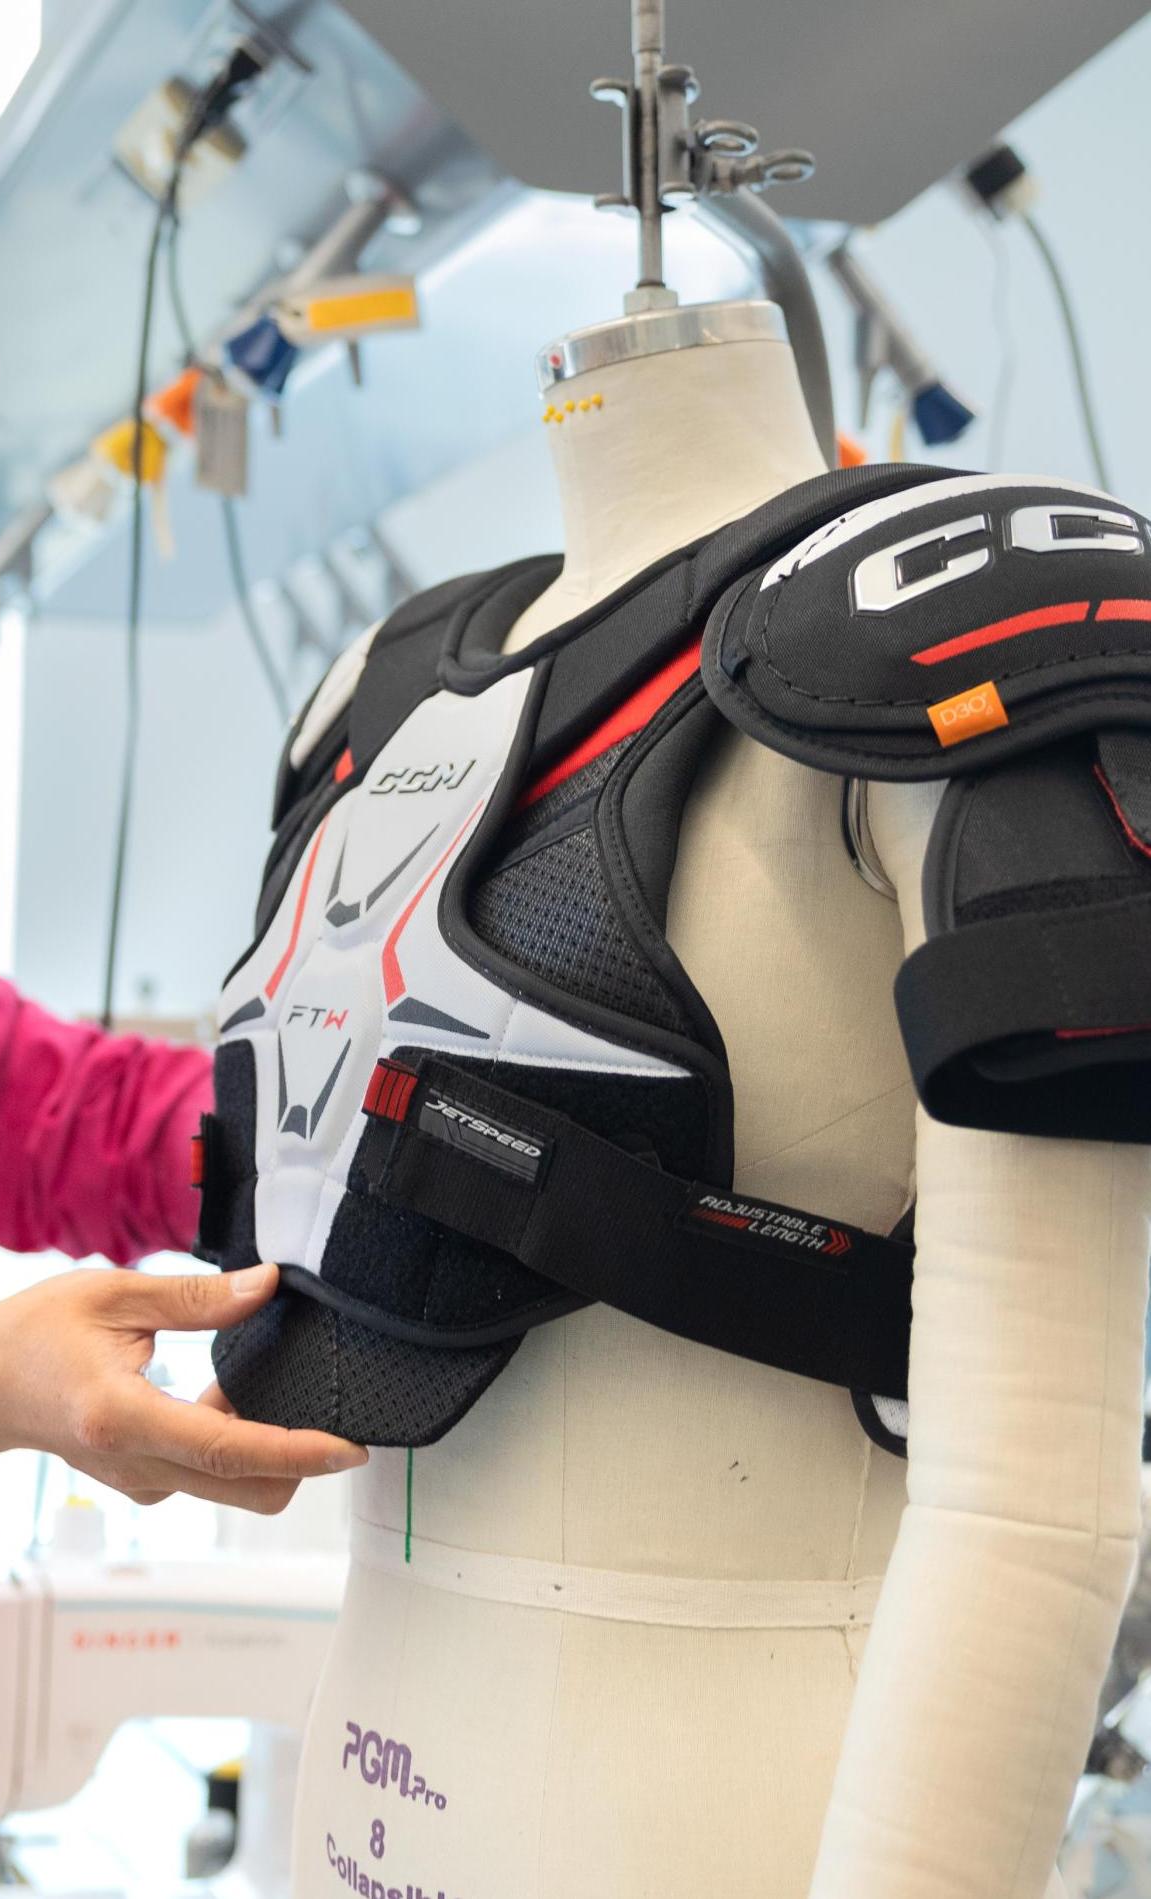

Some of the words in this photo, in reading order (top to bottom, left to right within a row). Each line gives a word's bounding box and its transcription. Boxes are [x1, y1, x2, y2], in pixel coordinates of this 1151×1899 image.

[852, 504, 1151, 613] CC
[369, 759, 477, 795] CCM
[286, 1005, 350, 1031] FTW
[424, 1100, 542, 1159] JETSPEED
[699, 1195, 828, 1238] ADJUSTABLE
[747, 1221, 827, 1251] LENGTH
[369, 1818, 386, 1860] 8
[326, 1832, 461, 1899] Collap
